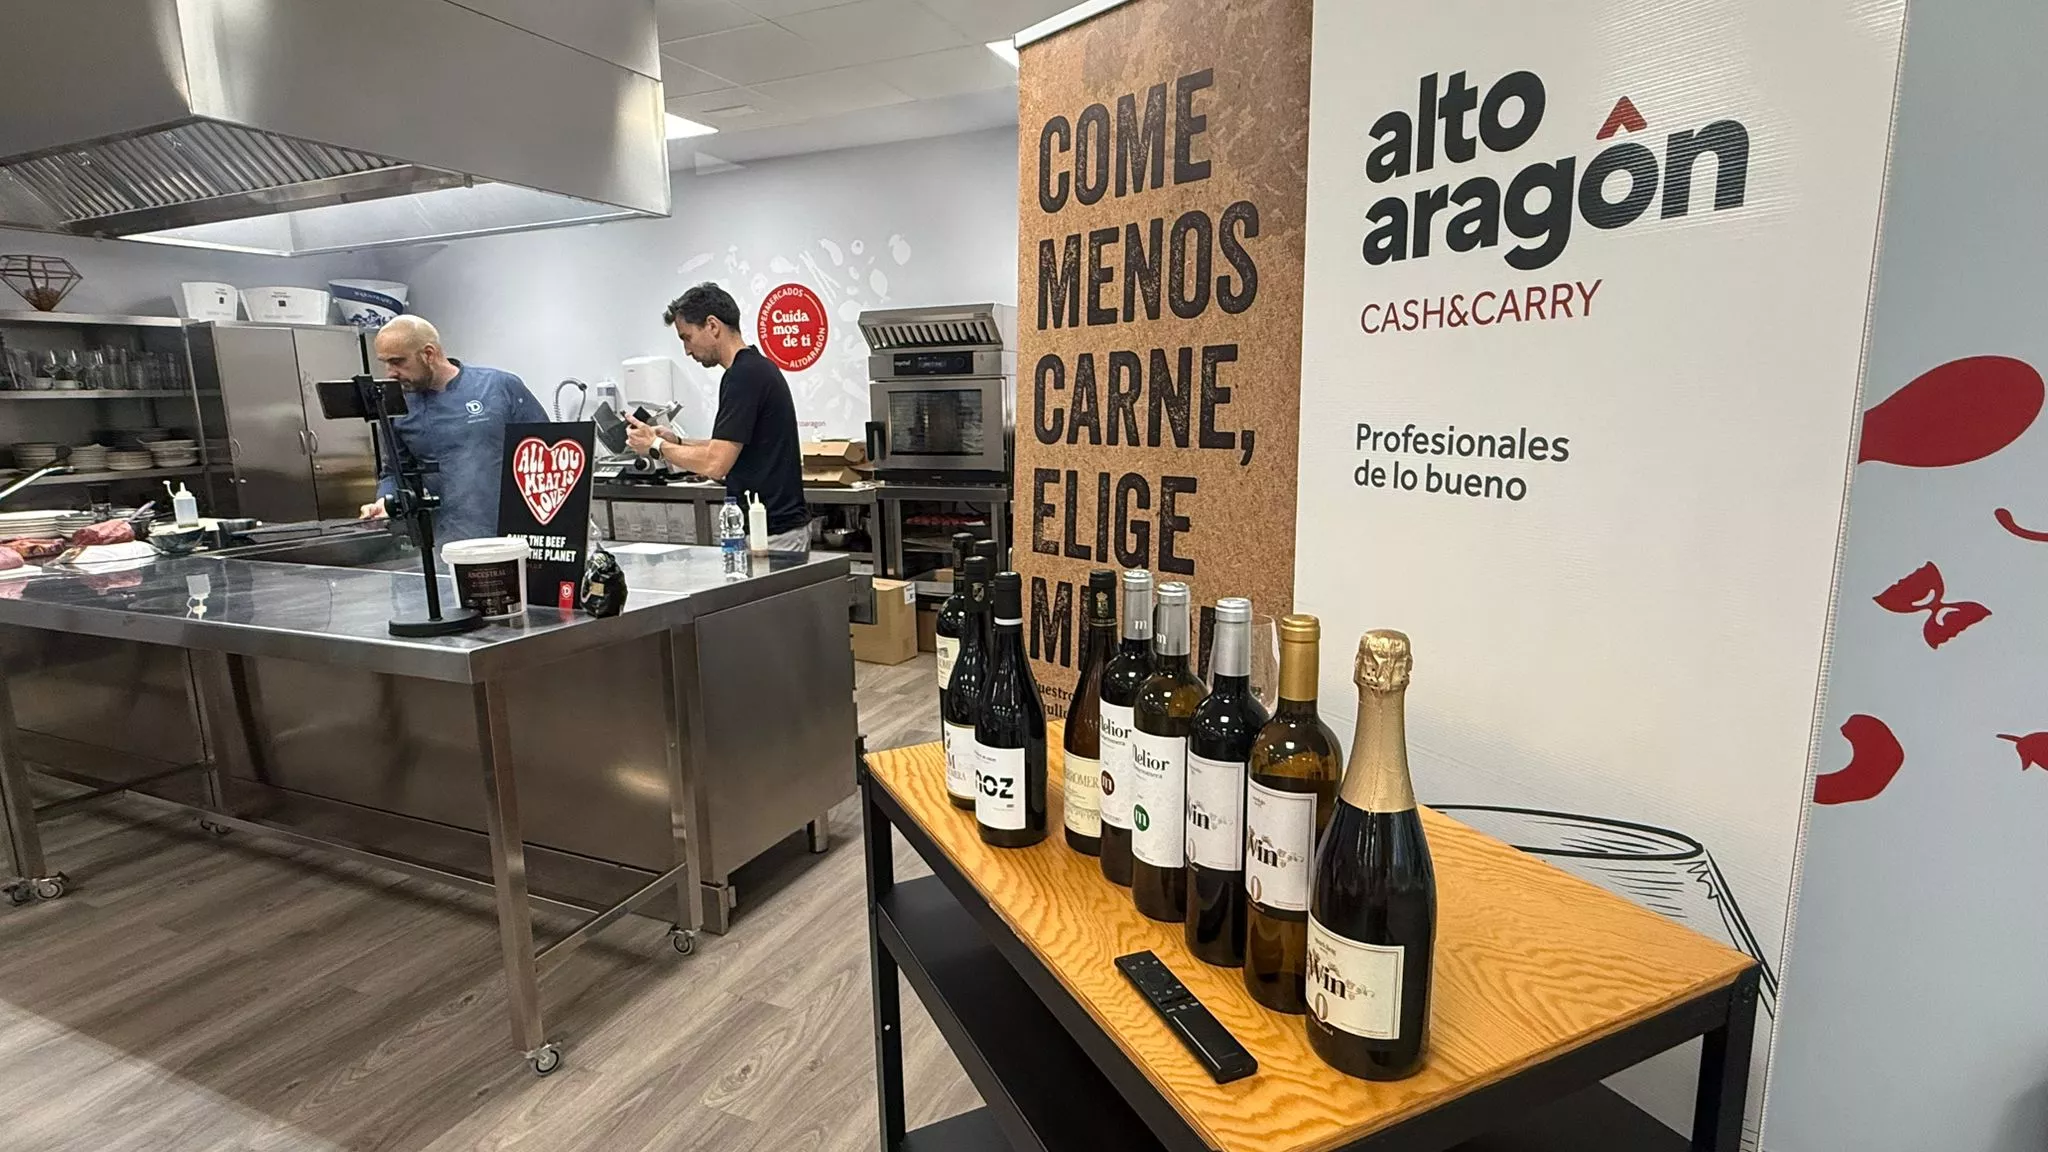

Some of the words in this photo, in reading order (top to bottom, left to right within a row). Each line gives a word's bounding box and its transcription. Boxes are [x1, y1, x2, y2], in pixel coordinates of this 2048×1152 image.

[1039, 67, 1214, 214] COME
[1366, 70, 1546, 184] alto
[1037, 200, 1260, 331] MENOS
[760, 287, 804, 339] SUPERMERCADOS
[772, 309, 810, 323] Cuida
[1361, 279, 1604, 334] CASH&CARRY
[773, 325, 799, 335] mos
[783, 335, 798, 347] de
[801, 334, 811, 347] ti
[1034, 344, 1255, 466] CARNE,
[518, 443, 545, 473] ALL
[551, 446, 579, 471] YOU
[1356, 423, 1570, 462] Profesionales
[524, 472, 561, 496] MEAT
[562, 470, 575, 487] IS
[1354, 459, 1386, 488] de
[1393, 461, 1418, 491] lo
[1425, 463, 1527, 501] bueno
[529, 488, 567, 520] LOVE
[1032, 467, 1197, 575] ELIGE
[529, 535, 545, 547] THE
[545, 536, 566, 548] BEEF
[545, 549, 577, 562] PLANET
[1135, 620, 1147, 630] m
